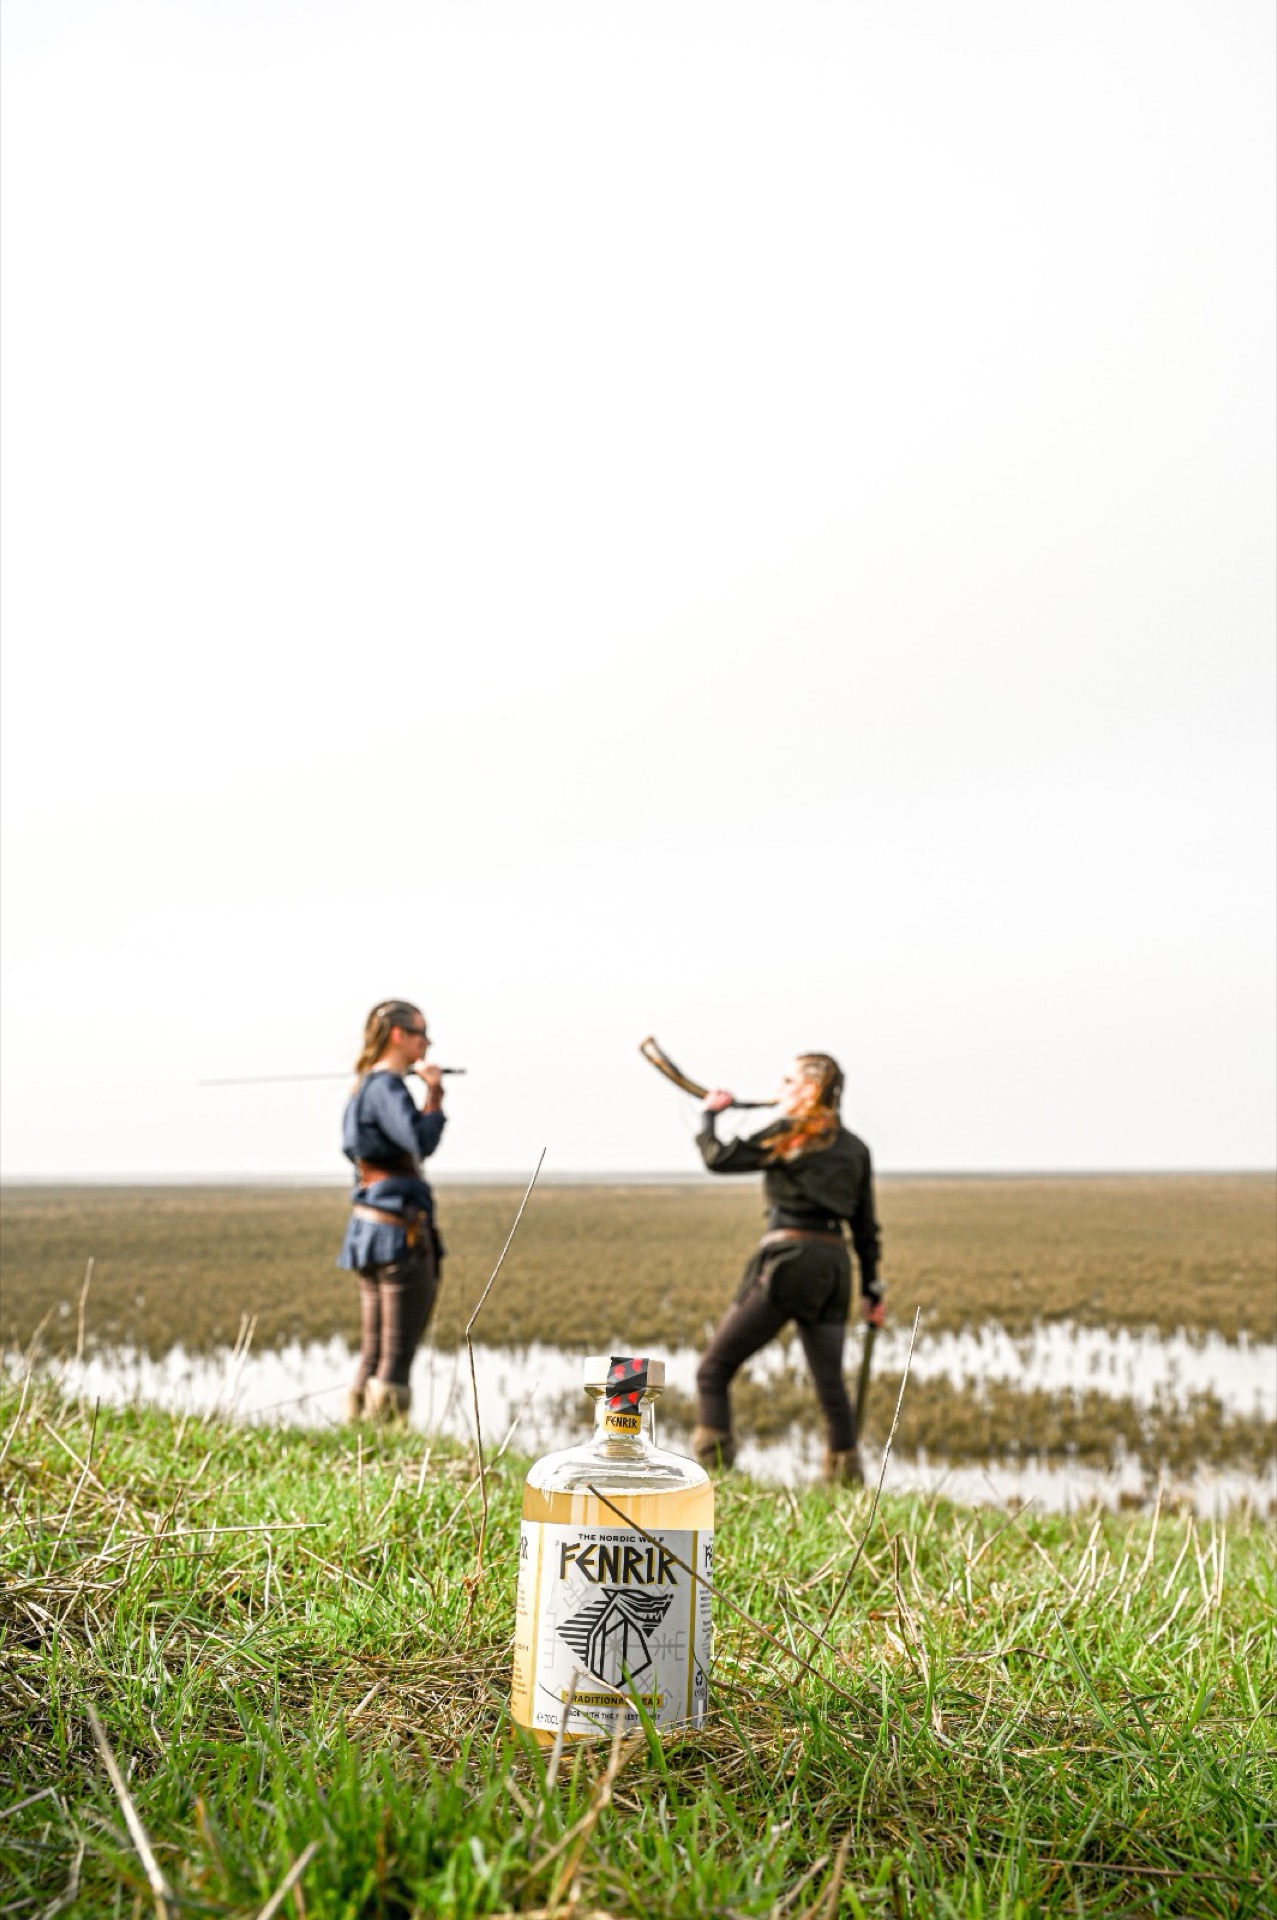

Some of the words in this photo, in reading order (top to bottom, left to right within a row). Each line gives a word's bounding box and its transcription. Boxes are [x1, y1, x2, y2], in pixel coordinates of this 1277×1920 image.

[605, 1415, 638, 1429] FENRIR
[578, 1533, 596, 1541] THE
[599, 1535, 636, 1543] NORDIC
[638, 1536, 665, 1544] WF
[559, 1541, 678, 1585] FENRIR
[565, 1693, 630, 1706] RADITIONA
